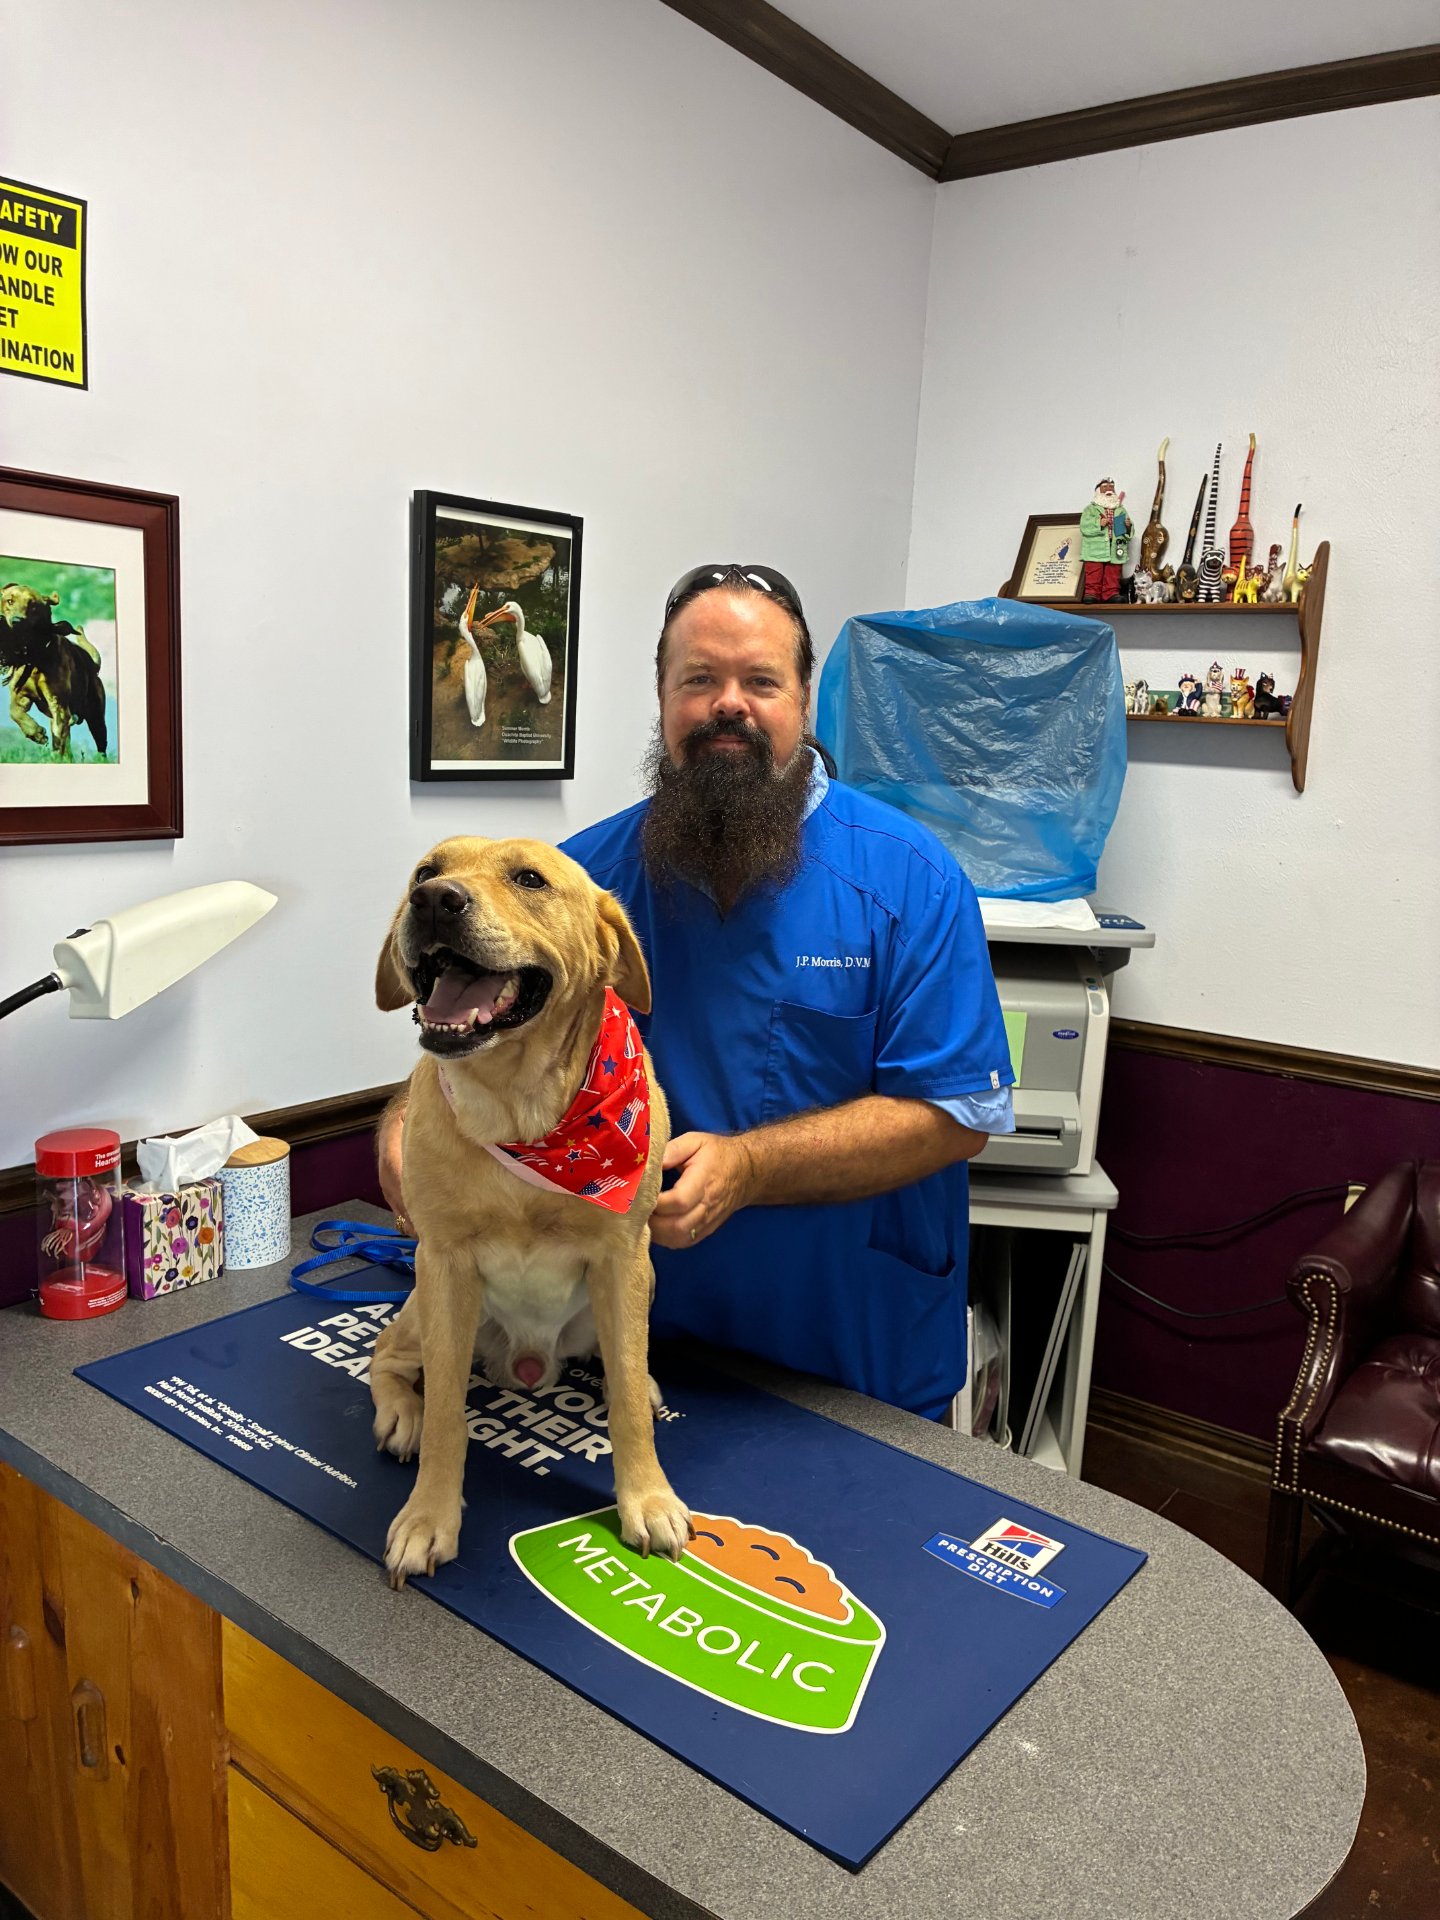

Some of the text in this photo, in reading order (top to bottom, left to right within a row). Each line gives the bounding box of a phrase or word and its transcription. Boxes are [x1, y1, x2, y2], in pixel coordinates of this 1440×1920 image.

[25, 249, 63, 278] OUR
[795, 955, 809, 968] J.P.
[811, 956, 843, 968] Morris,
[156, 1380, 177, 1392] Mark
[172, 1389, 197, 1404] Morris
[174, 1403, 189, 1413] Pet
[210, 1426, 224, 1436] Inc.
[486, 1389, 612, 1463] THEIR
[247, 1422, 274, 1436] Small
[267, 1434, 299, 1451] Animal
[294, 1449, 326, 1467] Clinical
[937, 1539, 1055, 1598] PRESCRIPTION
[979, 1541, 1032, 1571] Hill's
[967, 1562, 1008, 1584] DIET
[557, 1533, 837, 1692] METABOLIC
